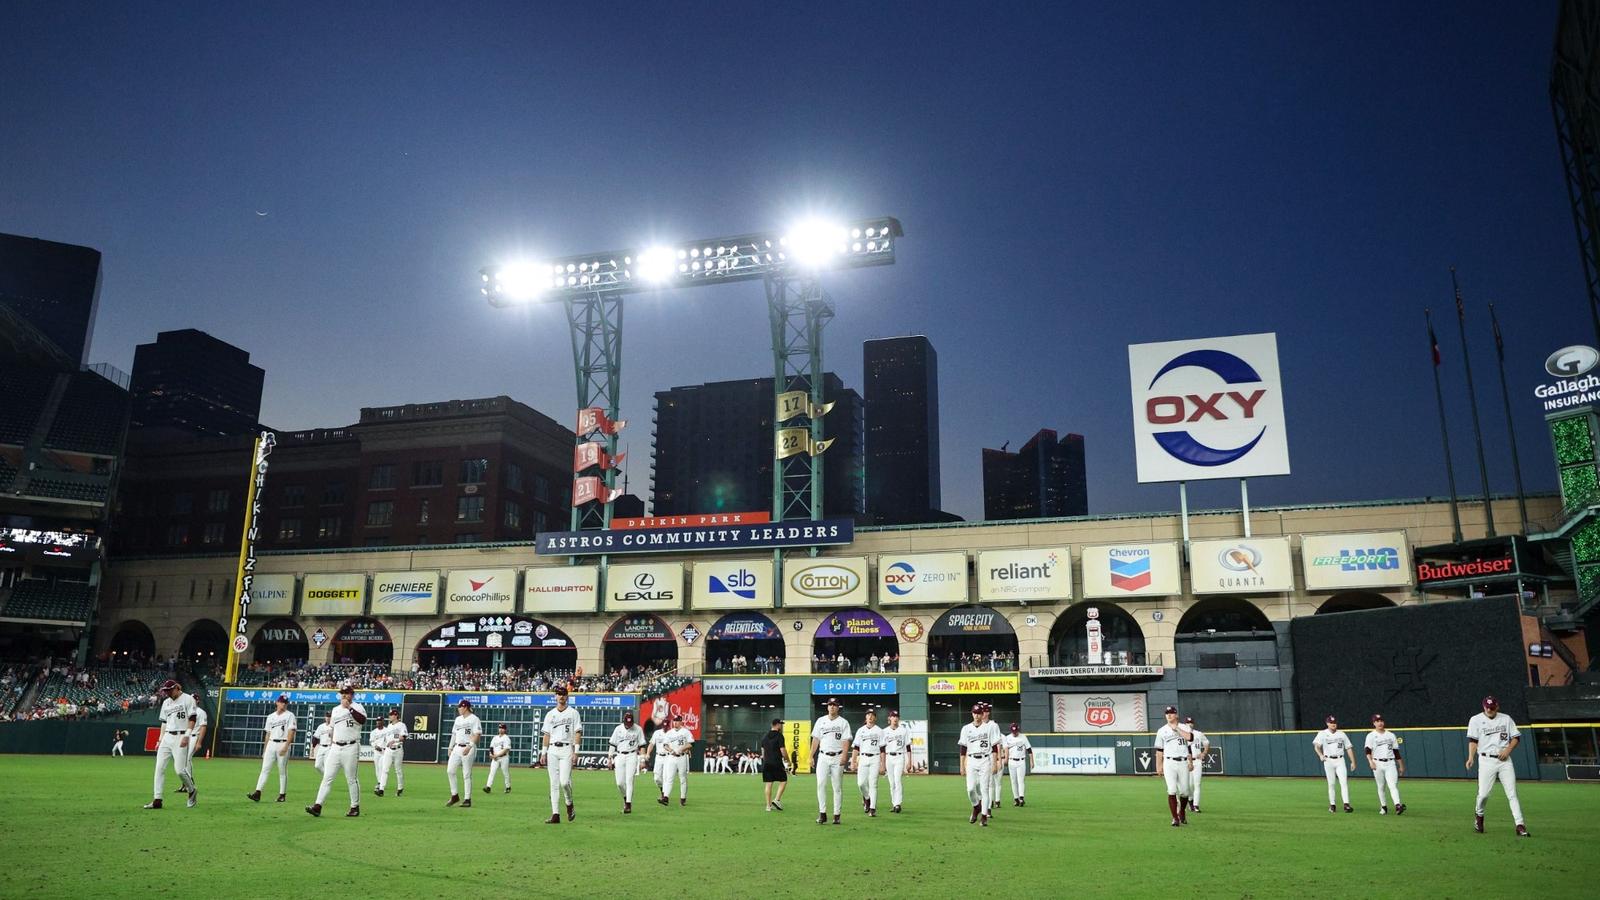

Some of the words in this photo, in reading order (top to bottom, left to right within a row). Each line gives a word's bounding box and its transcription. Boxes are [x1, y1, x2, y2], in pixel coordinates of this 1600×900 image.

[1534, 374, 1600, 398] Gallagh
[784, 396, 800, 412] 17
[1146, 389, 1267, 425] OXY
[782, 435, 798, 449] 22
[581, 448, 594, 462] 19
[577, 482, 590, 496] 21
[248, 460, 268, 541] CHIKIN
[628, 516, 688, 527] DAIKIN
[700, 514, 742, 524] PARK
[547, 535, 613, 549] ASTROS
[622, 529, 742, 546] COMMUNITY
[750, 525, 839, 541] LEADERS
[245, 545, 257, 571] IZ
[1109, 548, 1150, 557] Chevron
[1314, 554, 1386, 566] FREEPORT
[1340, 547, 1400, 571] LNG
[990, 563, 1051, 581] reliant
[1418, 558, 1513, 581] Budweiser
[727, 569, 756, 588] slb
[800, 573, 849, 590] COTTON
[885, 574, 916, 584] OXY
[922, 573, 945, 583] ZERO
[1219, 577, 1265, 588] QUANTA
[379, 582, 433, 592] CHENIERE
[528, 585, 594, 593] HALLIBURTON
[1000, 585, 1017, 593] NRG
[1018, 586, 1051, 594] company
[251, 590, 288, 599] CALPINE
[308, 590, 359, 598] DOGGETT
[450, 592, 510, 602] ConocoPhillips
[614, 590, 674, 601] LEXUS
[238, 575, 253, 633] FAIR
[846, 618, 874, 628] planet
[948, 614, 975, 627] SPACE
[975, 613, 995, 626] CITY
[725, 622, 765, 634] RELENTLESS
[850, 625, 880, 634] fitness
[262, 628, 300, 641] MAVEN
[1038, 668, 1069, 676] PROVIDING
[958, 681, 980, 691] PAPA
[982, 680, 1014, 690] JOHN'S
[296, 692, 317, 700] Through
[1090, 709, 1110, 721] 66
[346, 720, 354, 728] 15
[565, 725, 570, 733] 5
[304, 705, 314, 756] NATIONAL
[980, 740, 989, 748] 25
[1052, 753, 1110, 769] Insperity
